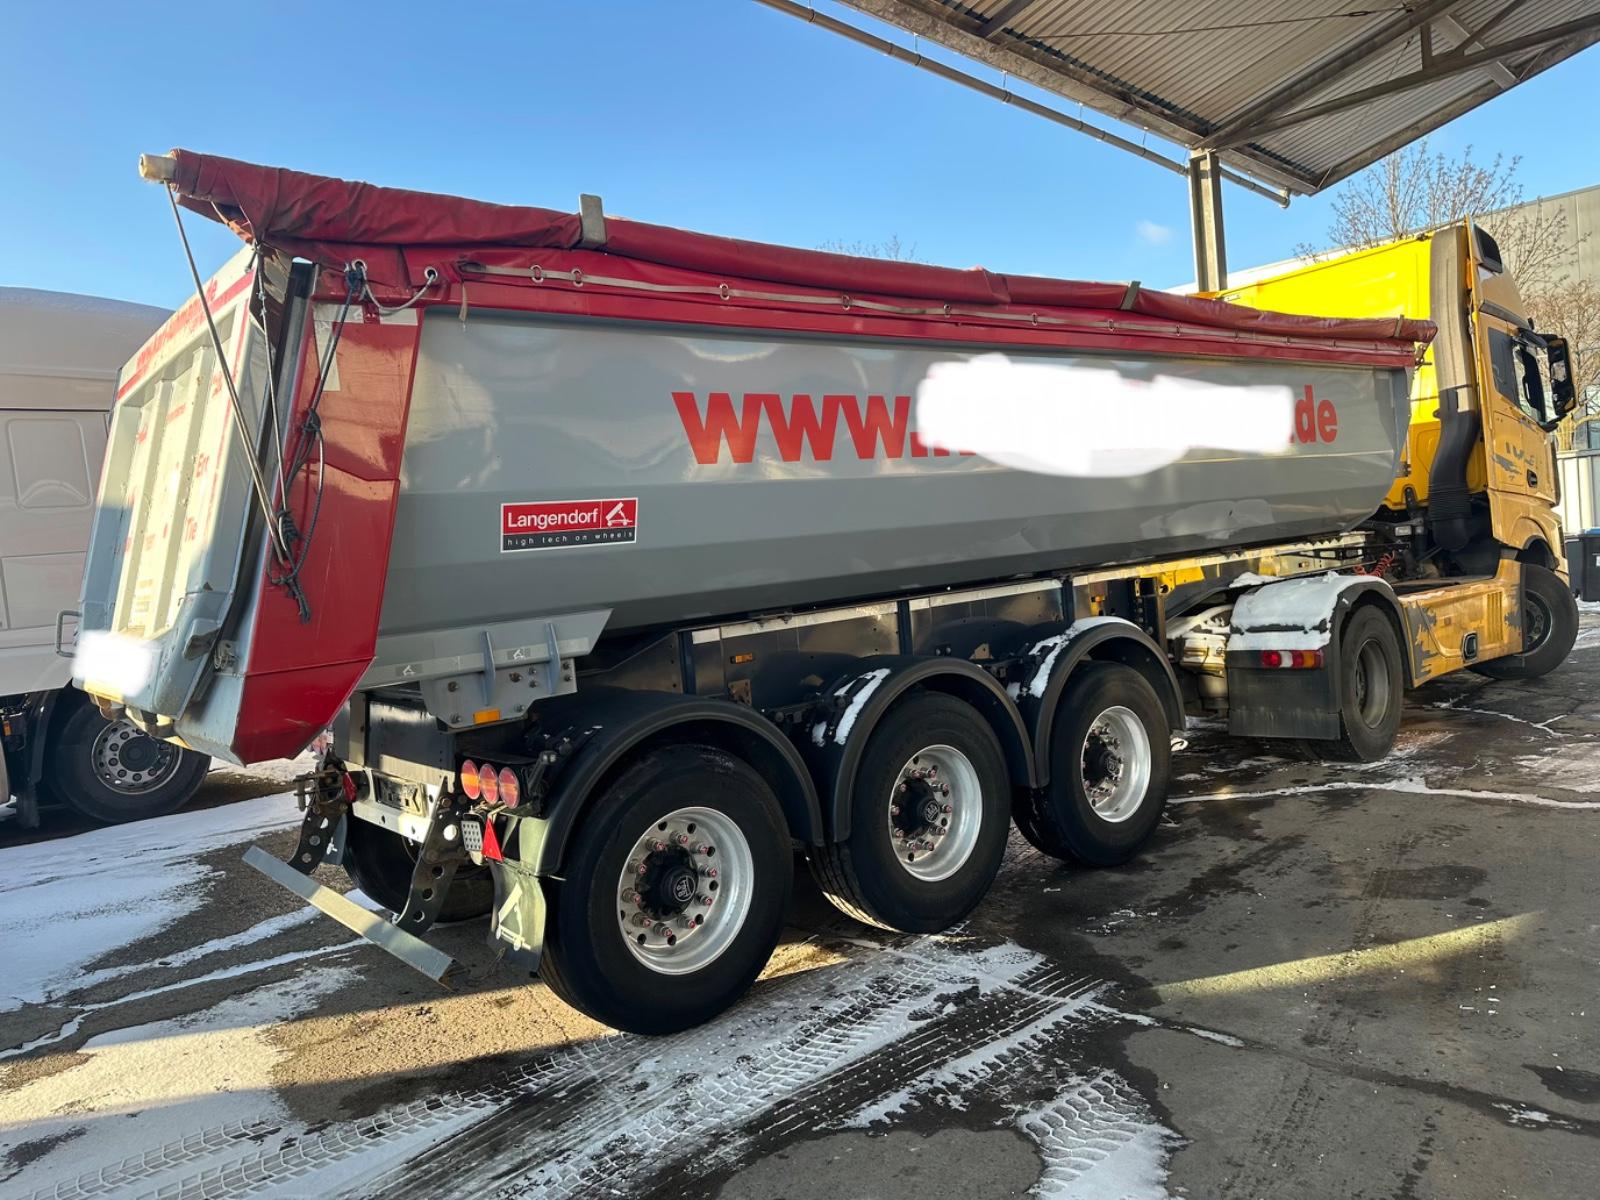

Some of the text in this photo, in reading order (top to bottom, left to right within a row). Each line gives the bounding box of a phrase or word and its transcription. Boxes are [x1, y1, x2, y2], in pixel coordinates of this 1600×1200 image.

[507, 508, 599, 530] Langendorf
[507, 531, 633, 547] high tech on wheels
